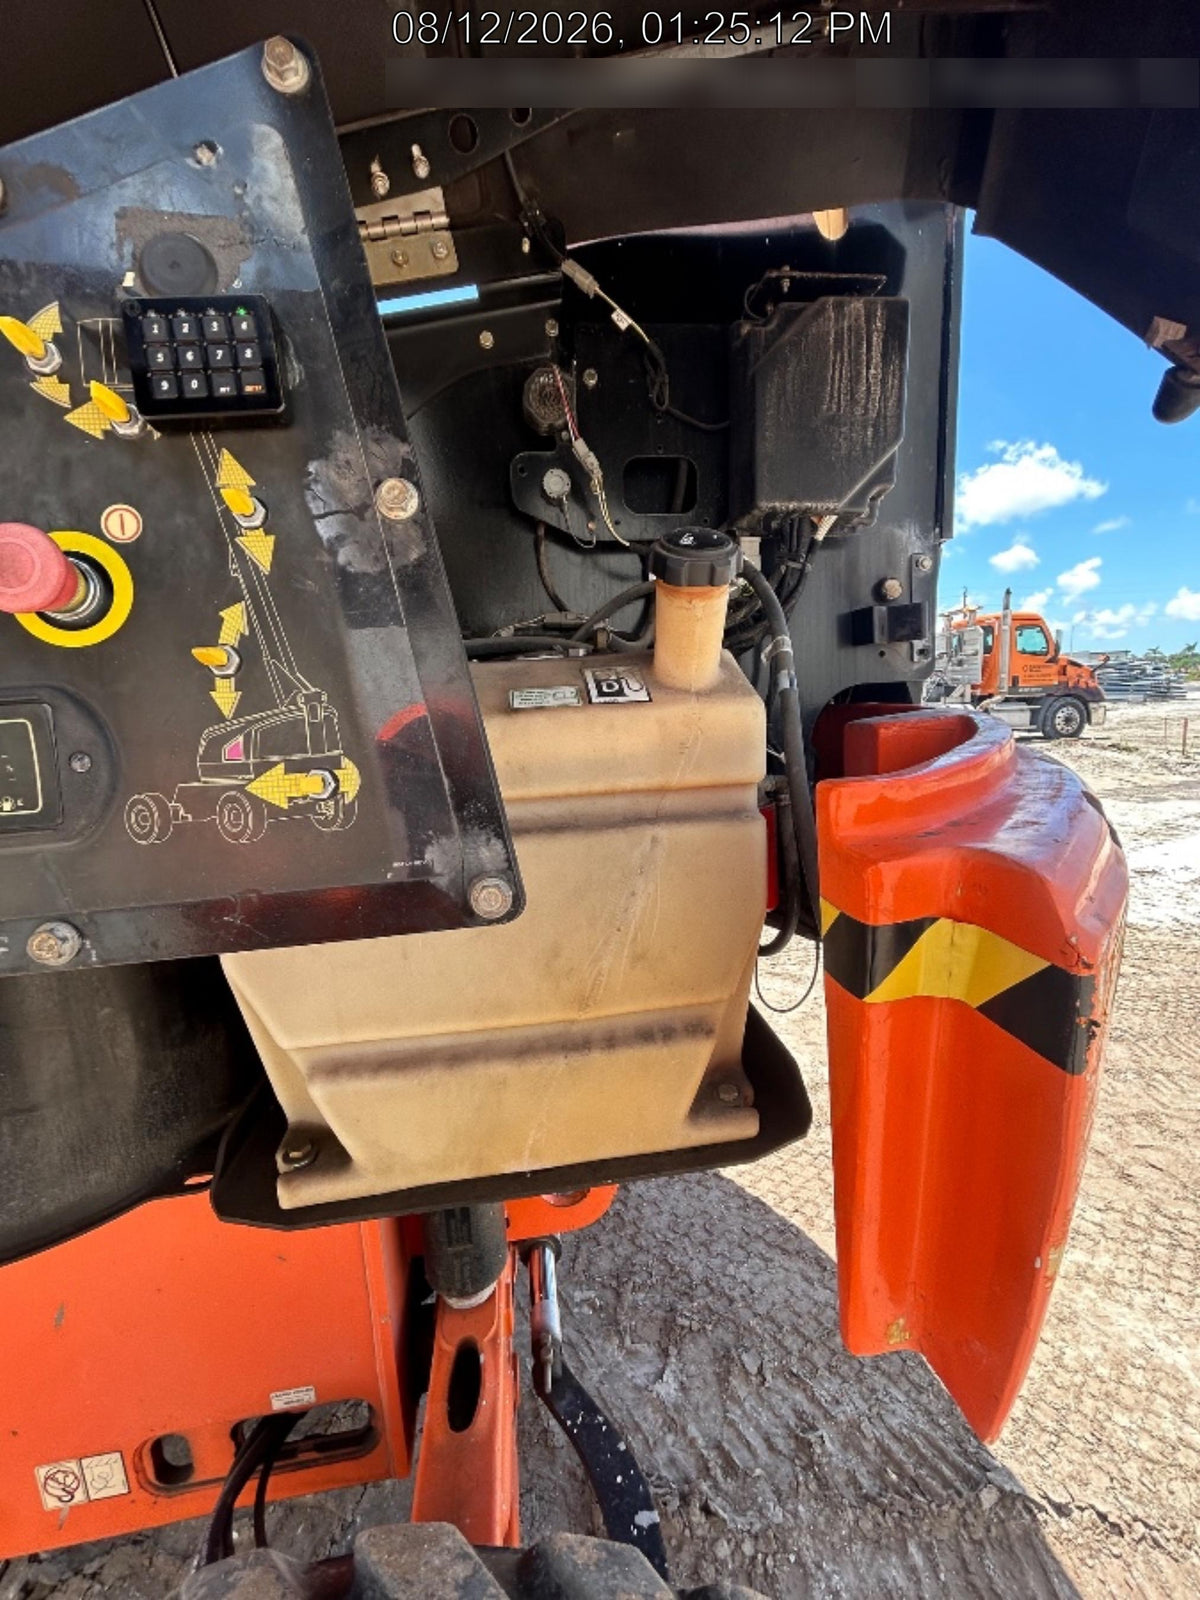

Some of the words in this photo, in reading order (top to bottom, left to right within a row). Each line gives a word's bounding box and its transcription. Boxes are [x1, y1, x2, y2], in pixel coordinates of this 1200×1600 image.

[152, 323, 159, 334] 1
[182, 323, 189, 333] 2
[212, 321, 219, 332] 3
[156, 352, 164, 363] 5
[186, 350, 194, 361] 6
[216, 349, 223, 360] 7
[244, 348, 252, 358] 8
[161, 380, 169, 391] 9
[191, 378, 198, 389] 0
